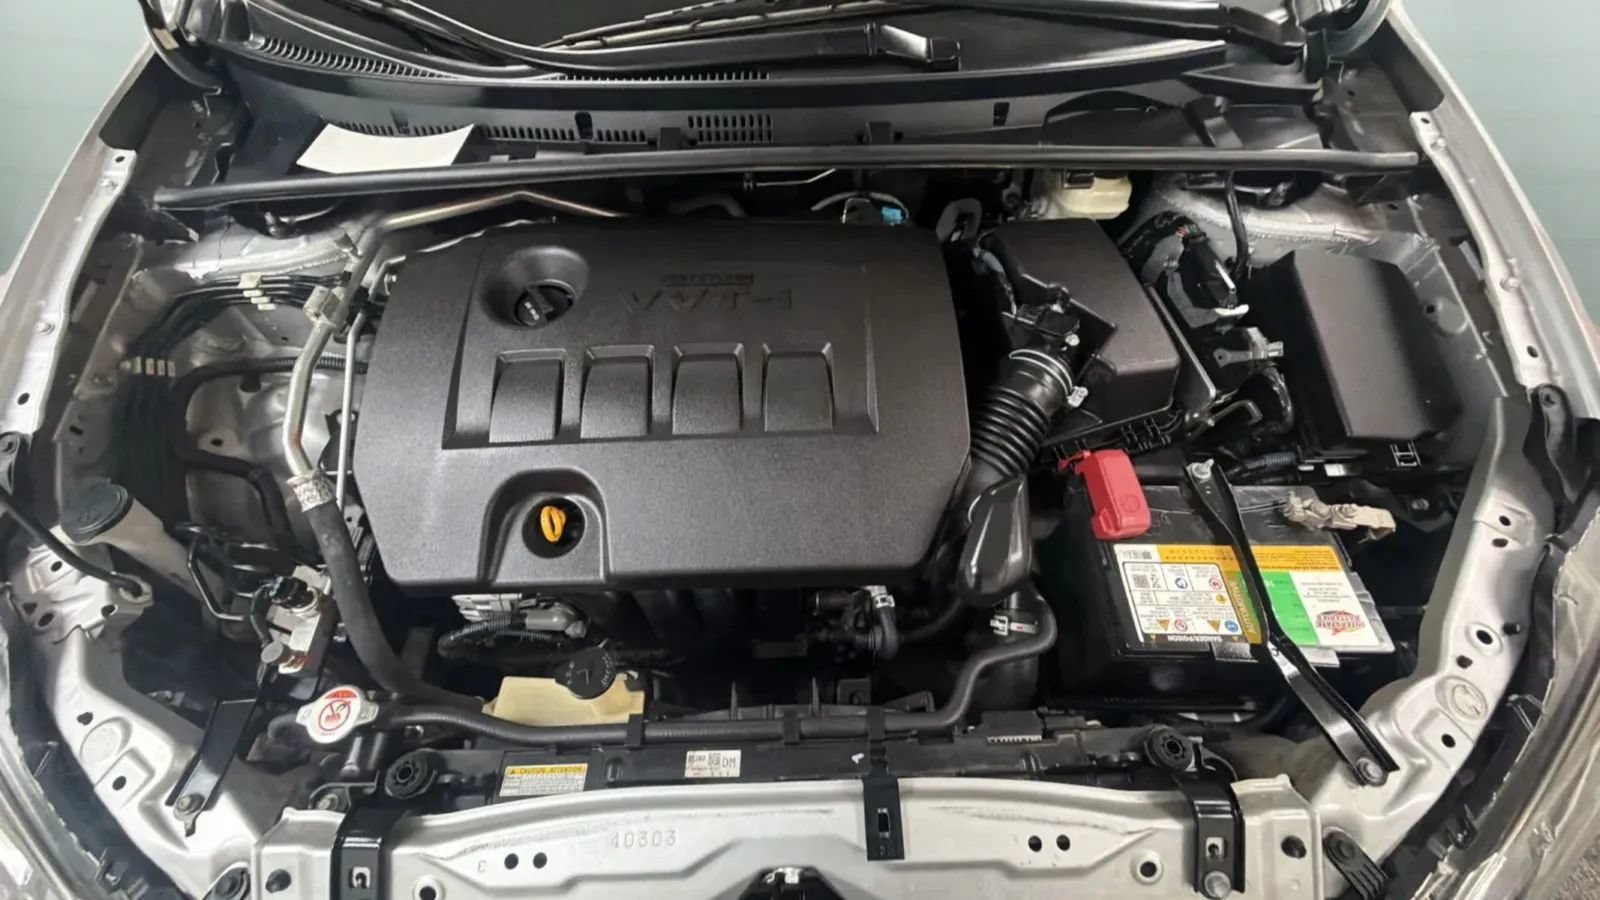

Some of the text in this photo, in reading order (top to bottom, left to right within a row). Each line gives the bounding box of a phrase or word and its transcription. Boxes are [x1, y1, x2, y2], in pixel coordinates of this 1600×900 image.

[722, 756, 736, 768] DM
[519, 765, 583, 775] CAUTION ATTENTION
[610, 829, 677, 850] 10303
